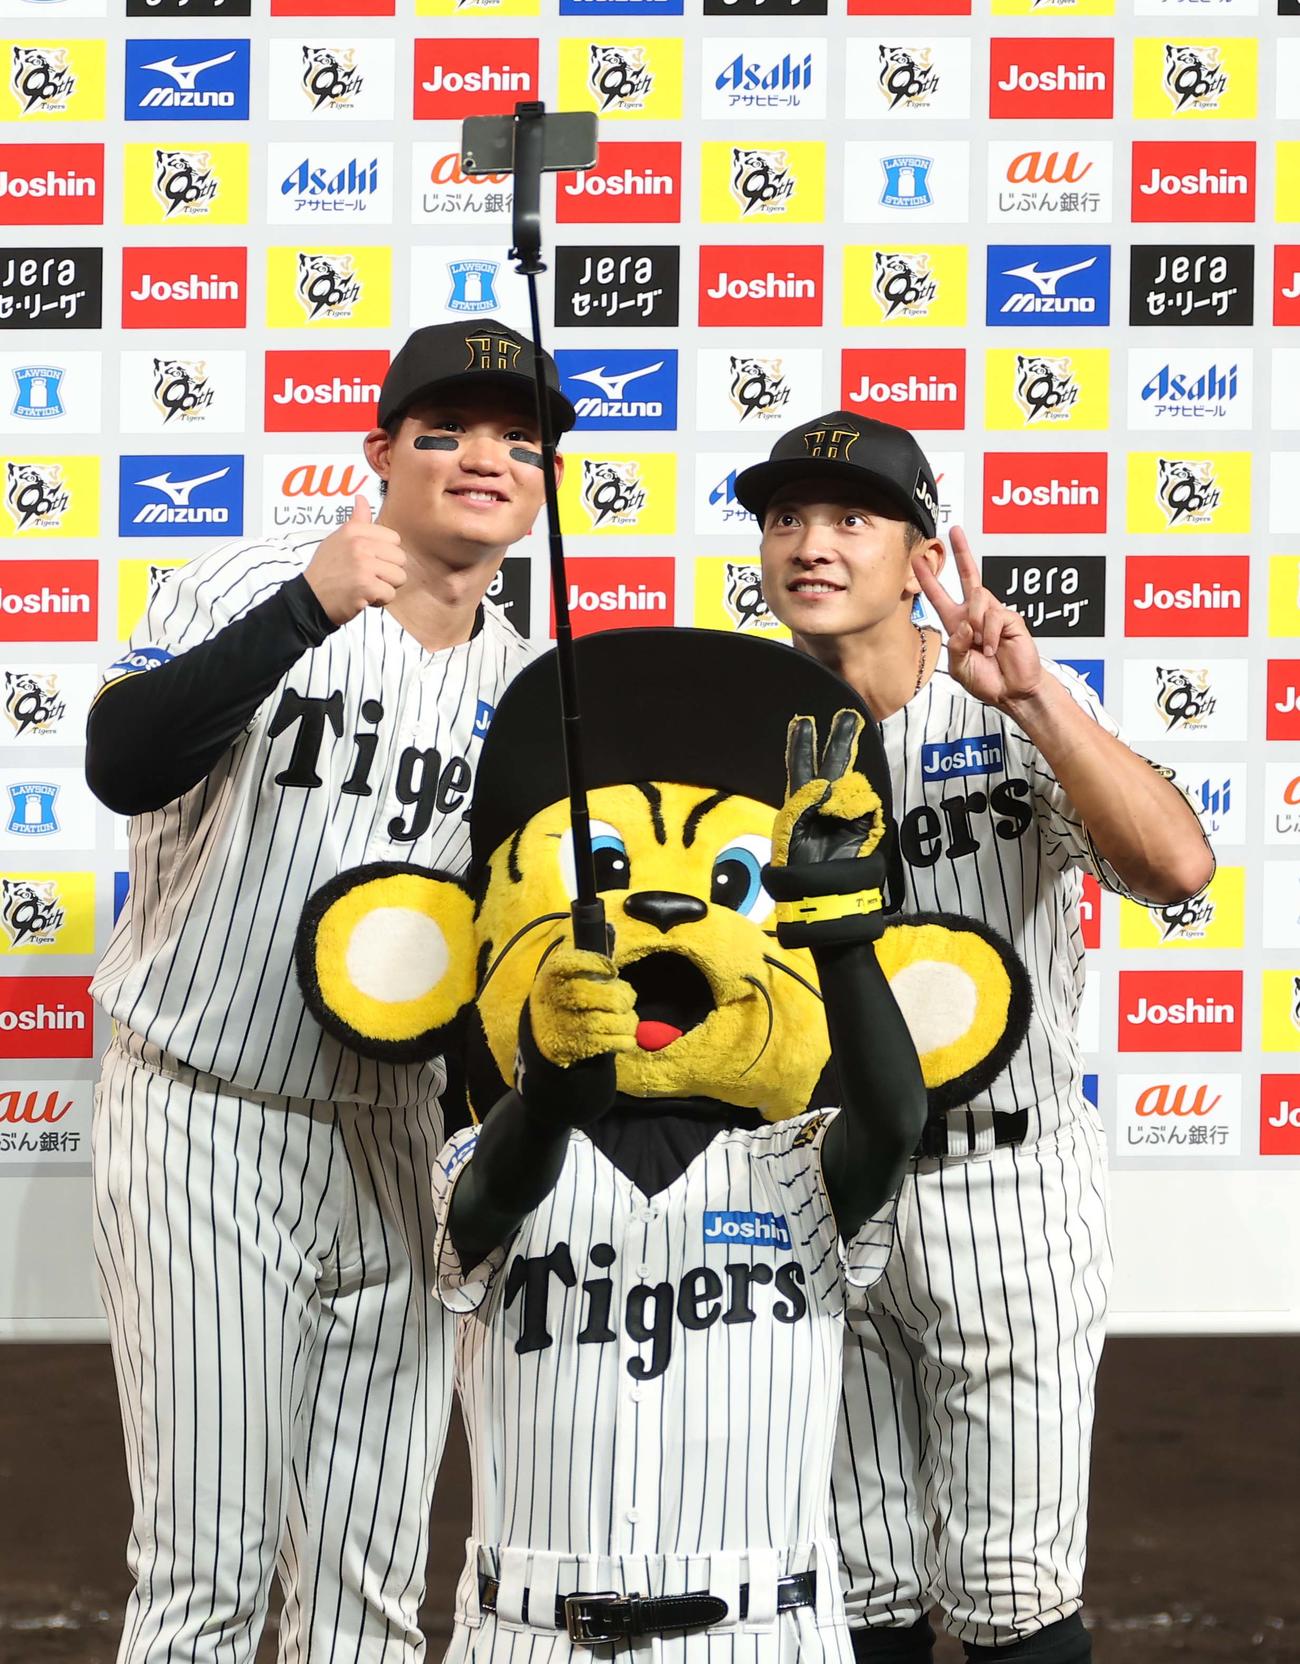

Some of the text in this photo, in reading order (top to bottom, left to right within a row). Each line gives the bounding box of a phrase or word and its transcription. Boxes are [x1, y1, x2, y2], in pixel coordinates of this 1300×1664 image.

[422, 66, 530, 92] Joshin
[715, 53, 811, 90] Asahi
[998, 66, 1105, 92] Joshin
[728, 94, 800, 106] アサヒビール
[884, 157, 930, 169] LAWSON
[1007, 152, 1093, 183] au
[281, 158, 377, 195] Asahi
[564, 170, 672, 196] Joshin
[1140, 169, 1247, 194] Joshin
[294, 199, 366, 211] アサヒビール
[884, 194, 930, 206] STATION
[999, 192, 1100, 212] じぶん銀行
[450, 262, 496, 274] LAWSON
[130, 275, 238, 300] Joshin
[708, 273, 815, 298] Joshin
[450, 299, 496, 311] STATION
[16, 368, 62, 380] LAWSON
[1141, 364, 1237, 401] Asahi
[274, 378, 381, 404] Joshin
[850, 377, 957, 402] Joshin
[16, 405, 62, 417] STATION
[1154, 405, 1226, 417] アサヒビール
[282, 465, 368, 496] au
[992, 480, 1099, 506] Joshin
[0, 588, 89, 614] oshin
[1134, 584, 1241, 610] Joshin
[267, 687, 472, 841] Tige
[923, 744, 1001, 775] Joshin
[11, 785, 57, 797] LAWSON
[11, 822, 57, 834] STATION
[1126, 998, 1234, 1024] Joshin
[1136, 1085, 1222, 1116] au
[1128, 1125, 1229, 1145] じぶん銀行
[705, 1216, 790, 1243] Joshin
[504, 1241, 806, 1381] Tigers
